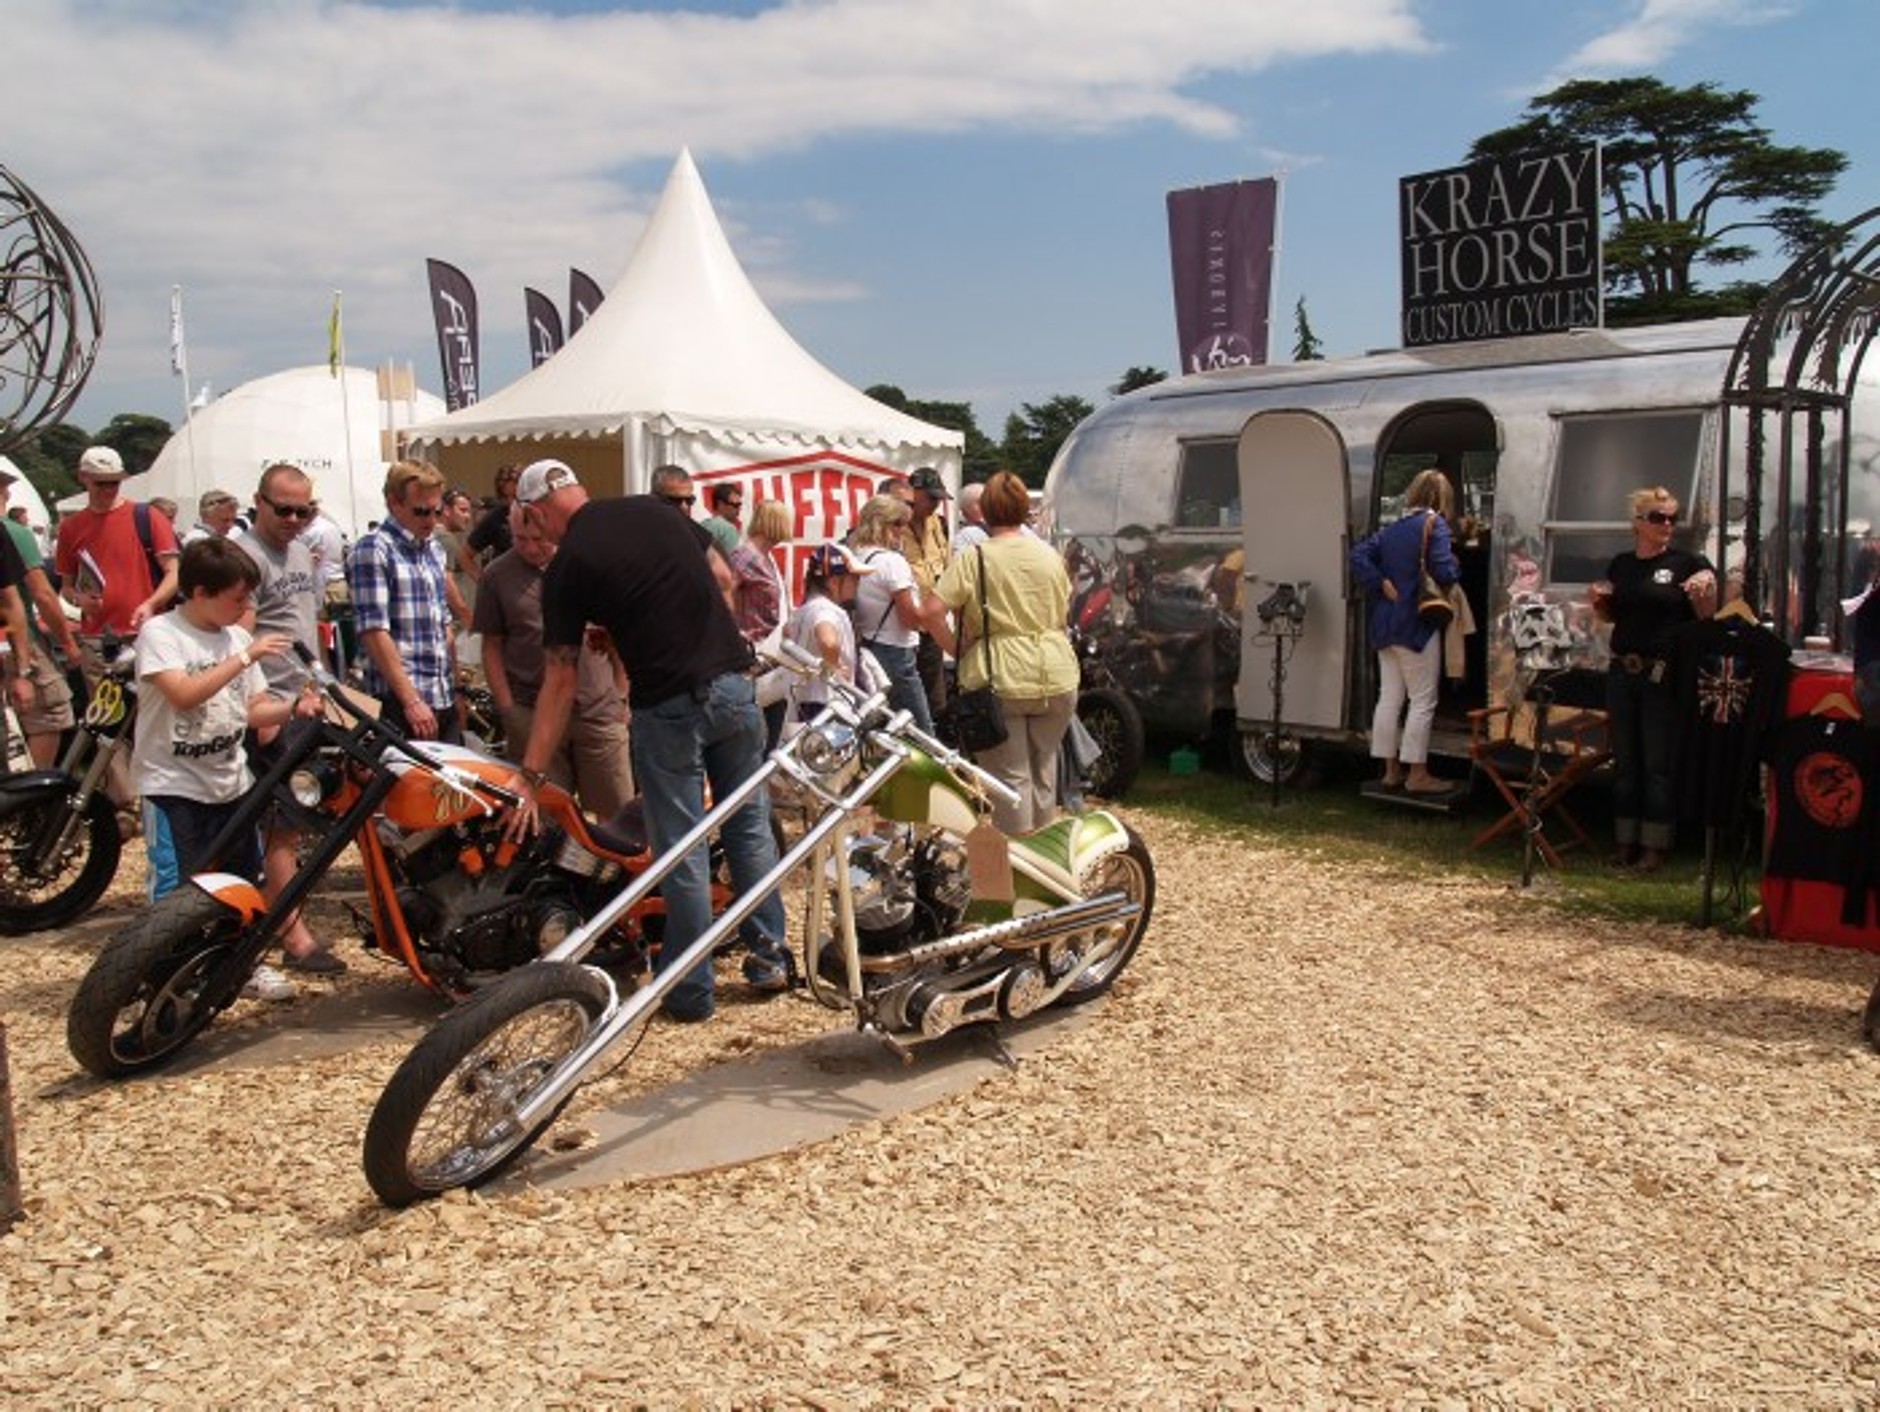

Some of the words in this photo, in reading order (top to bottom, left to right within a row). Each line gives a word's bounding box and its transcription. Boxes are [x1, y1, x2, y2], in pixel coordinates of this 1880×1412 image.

[1405, 148, 1594, 241] KRAZY
[1410, 217, 1595, 300] HORSE
[1406, 297, 1500, 344] CUSTOM
[1506, 286, 1598, 334] CYCLES
